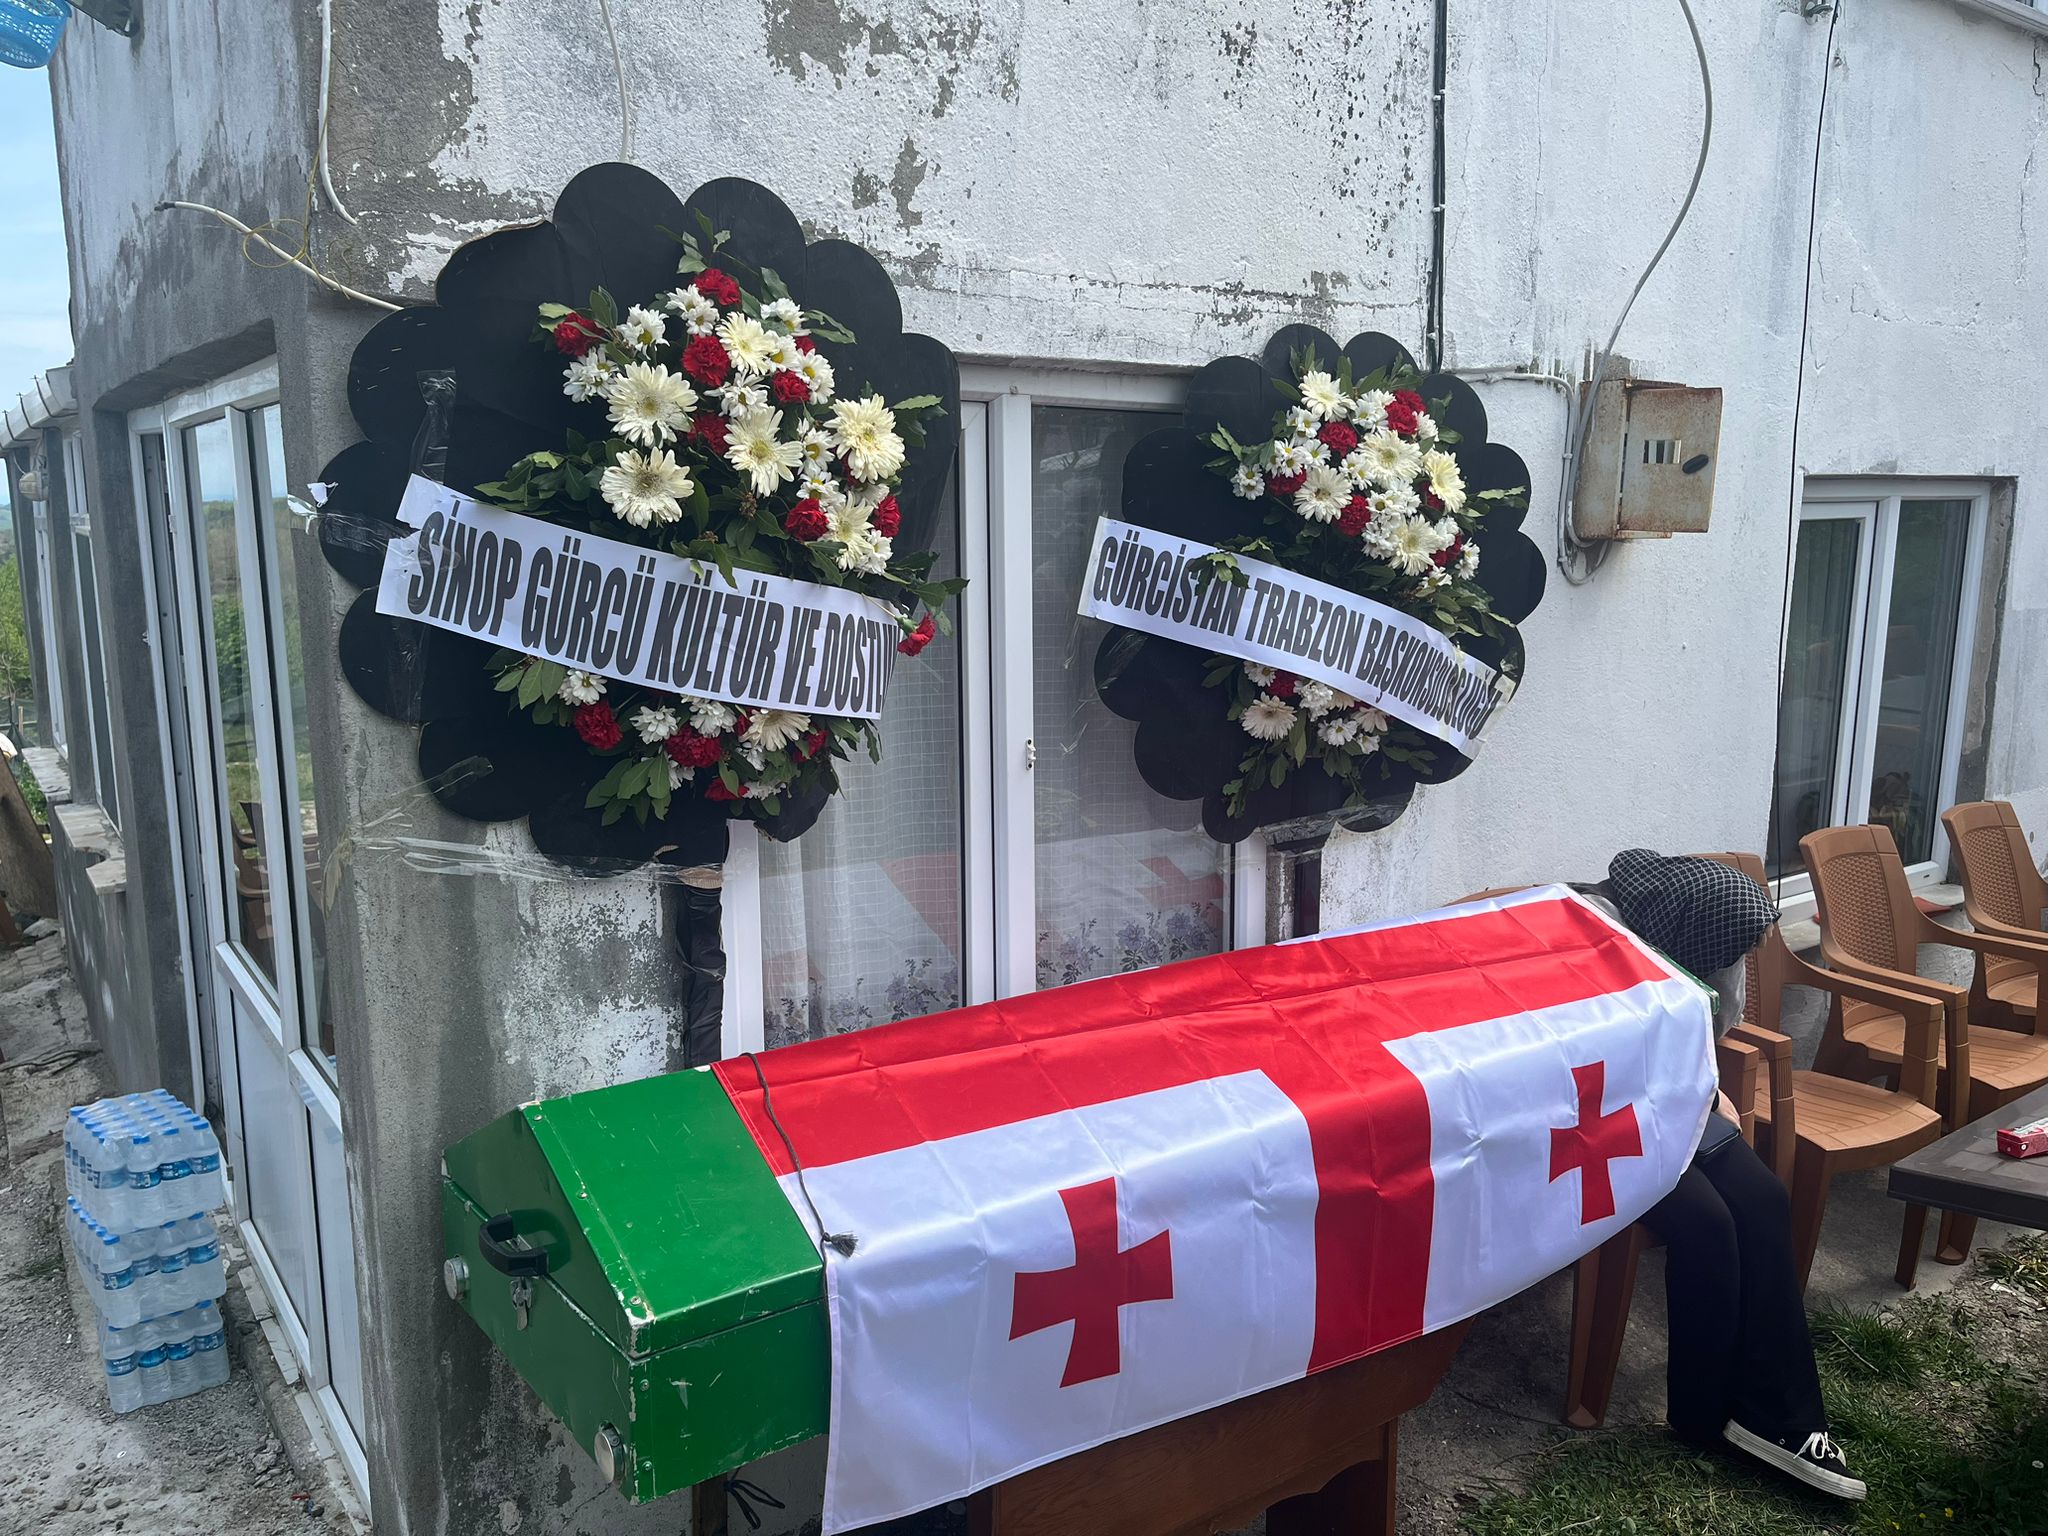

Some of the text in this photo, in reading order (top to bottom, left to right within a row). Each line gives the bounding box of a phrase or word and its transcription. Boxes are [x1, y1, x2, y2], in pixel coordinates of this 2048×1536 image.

[408, 500, 522, 636] SİNOP
[521, 535, 657, 676] GÜRCÜ
[645, 569, 785, 701] KÜLTÜR
[779, 606, 822, 706] VE
[1245, 577, 1365, 675] TRABZON
